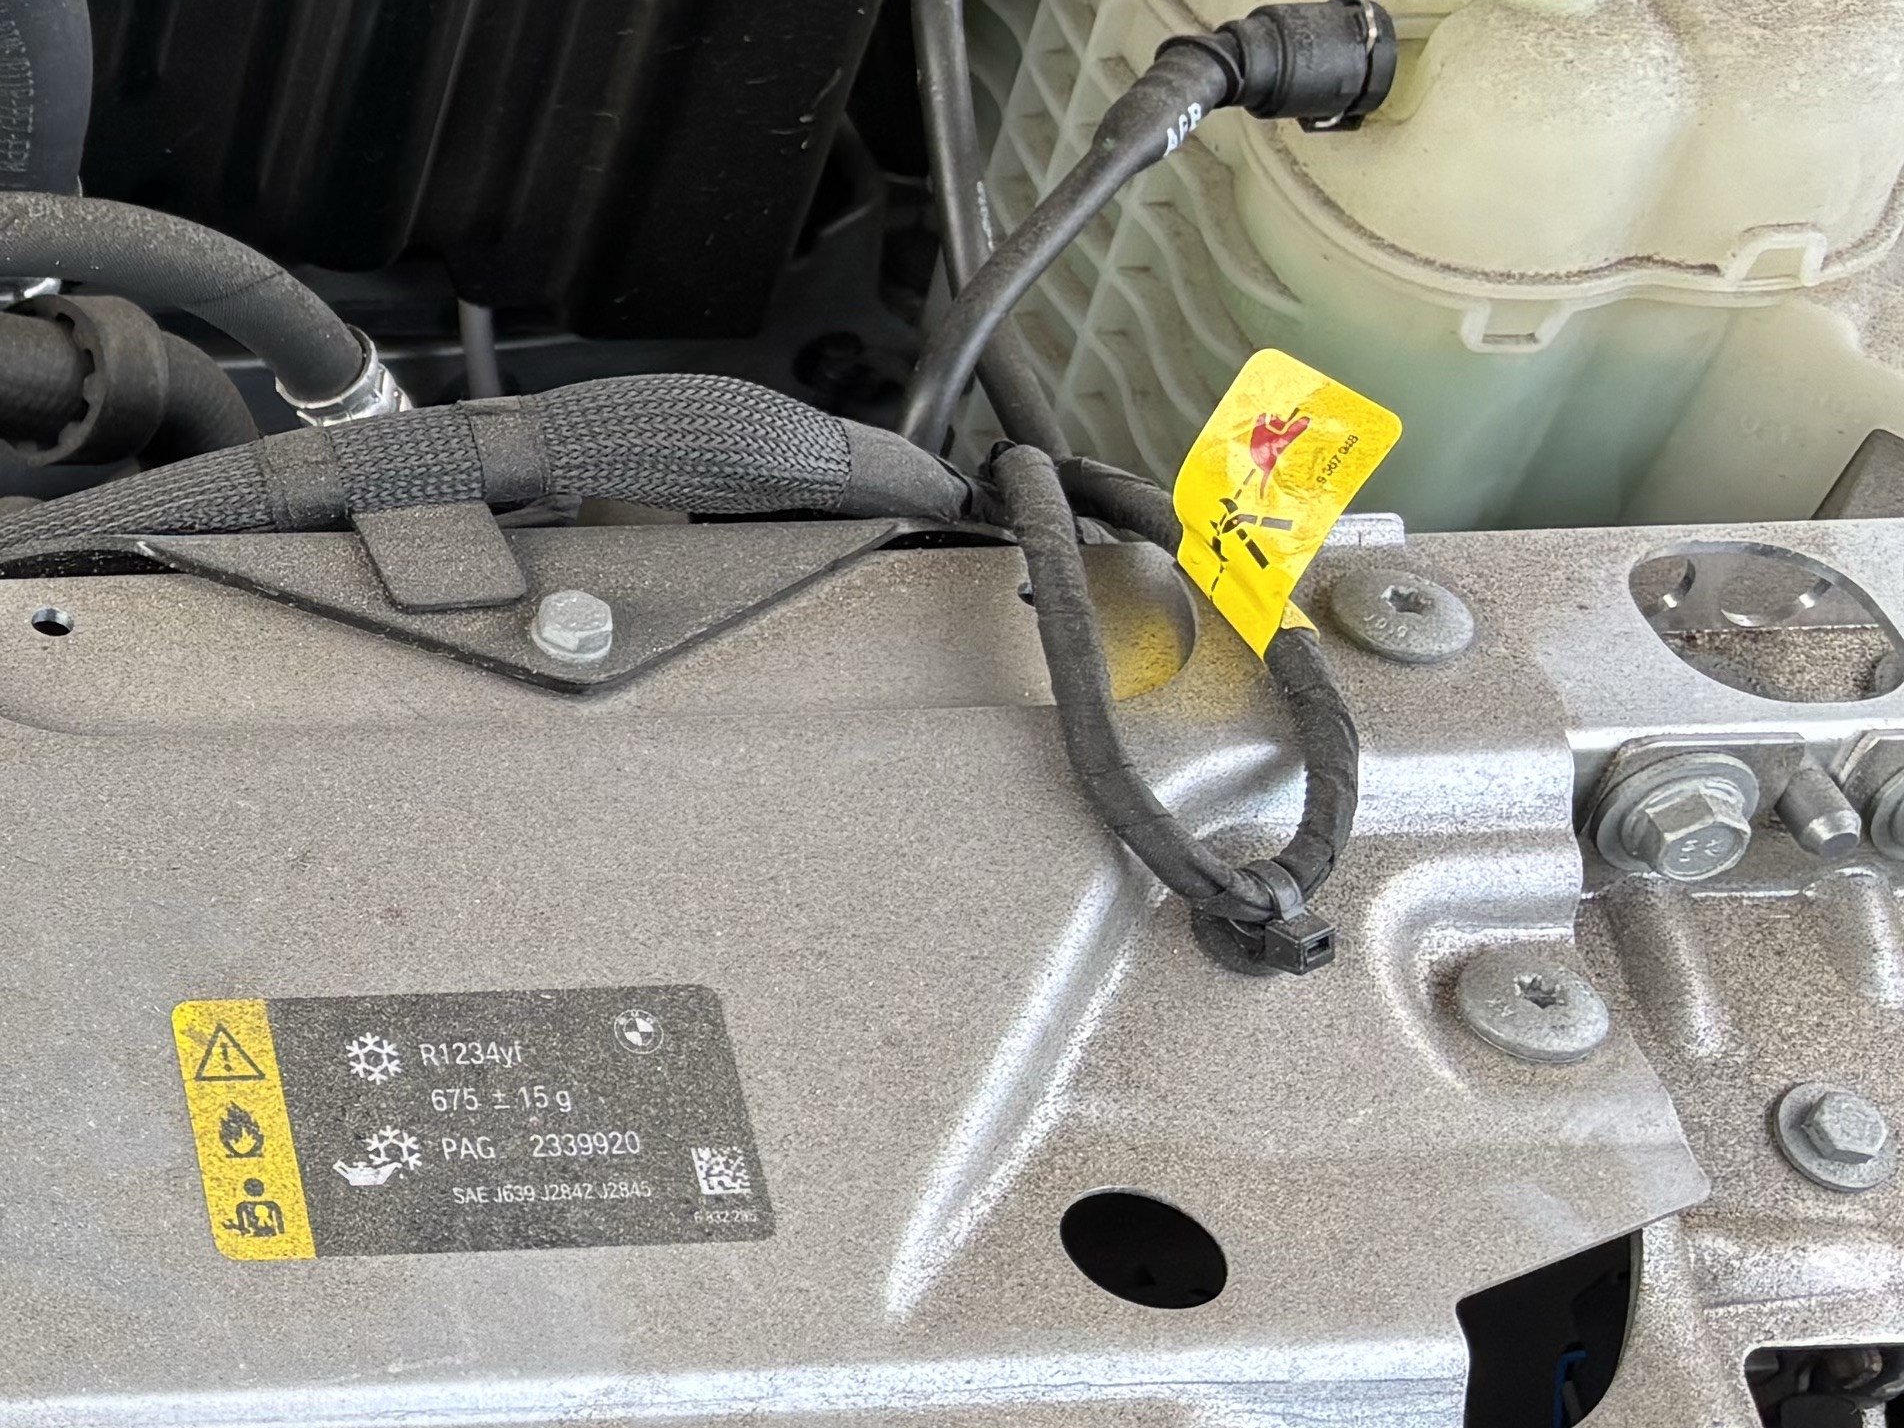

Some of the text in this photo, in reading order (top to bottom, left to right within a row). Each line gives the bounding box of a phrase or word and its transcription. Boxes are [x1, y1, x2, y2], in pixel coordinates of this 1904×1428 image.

[420, 1044, 522, 1068] R1234yf
[431, 1090, 477, 1111] 675
[519, 1087, 550, 1109] 15
[557, 1090, 571, 1112] g
[442, 1132, 640, 1160] PAG 2339920
[454, 1181, 652, 1204] SAE J639 J2842 J2845
